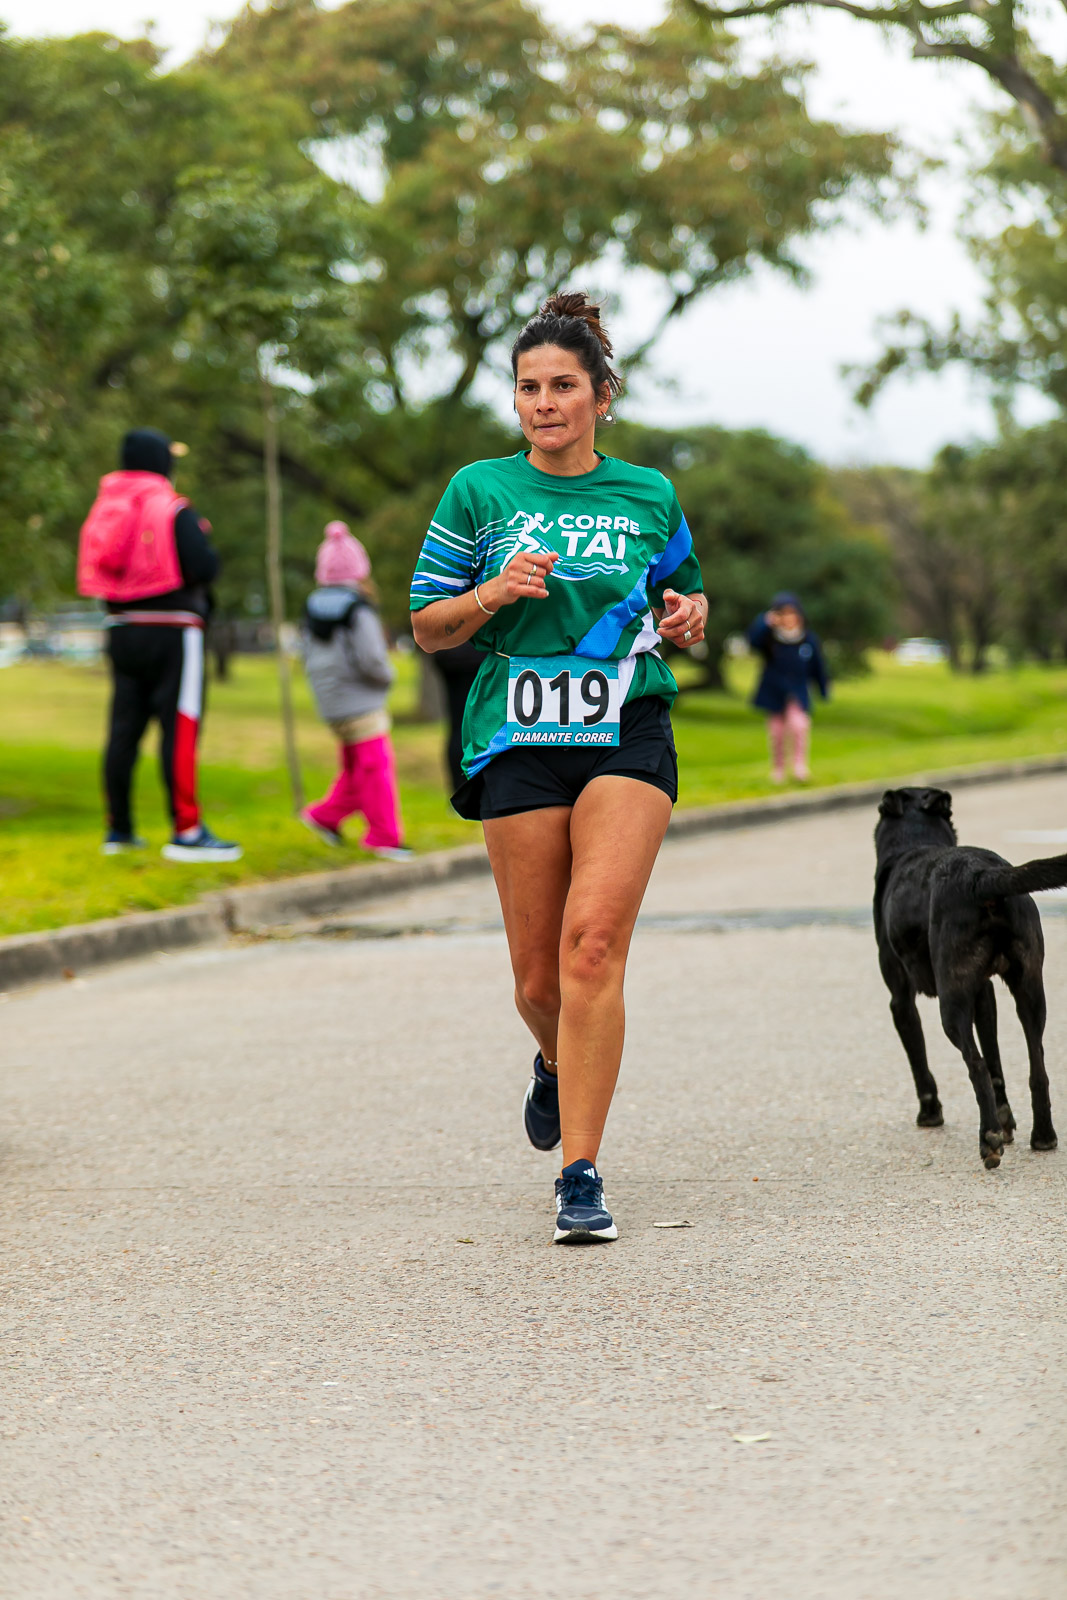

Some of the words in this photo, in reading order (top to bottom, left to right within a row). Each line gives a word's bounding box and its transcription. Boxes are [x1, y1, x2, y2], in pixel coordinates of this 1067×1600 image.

[557, 513, 641, 536] CORRE
[560, 530, 626, 560] TAI
[513, 669, 610, 728] 019
[511, 732, 572, 743] DIAMANTE
[574, 732, 613, 743] CORRE
